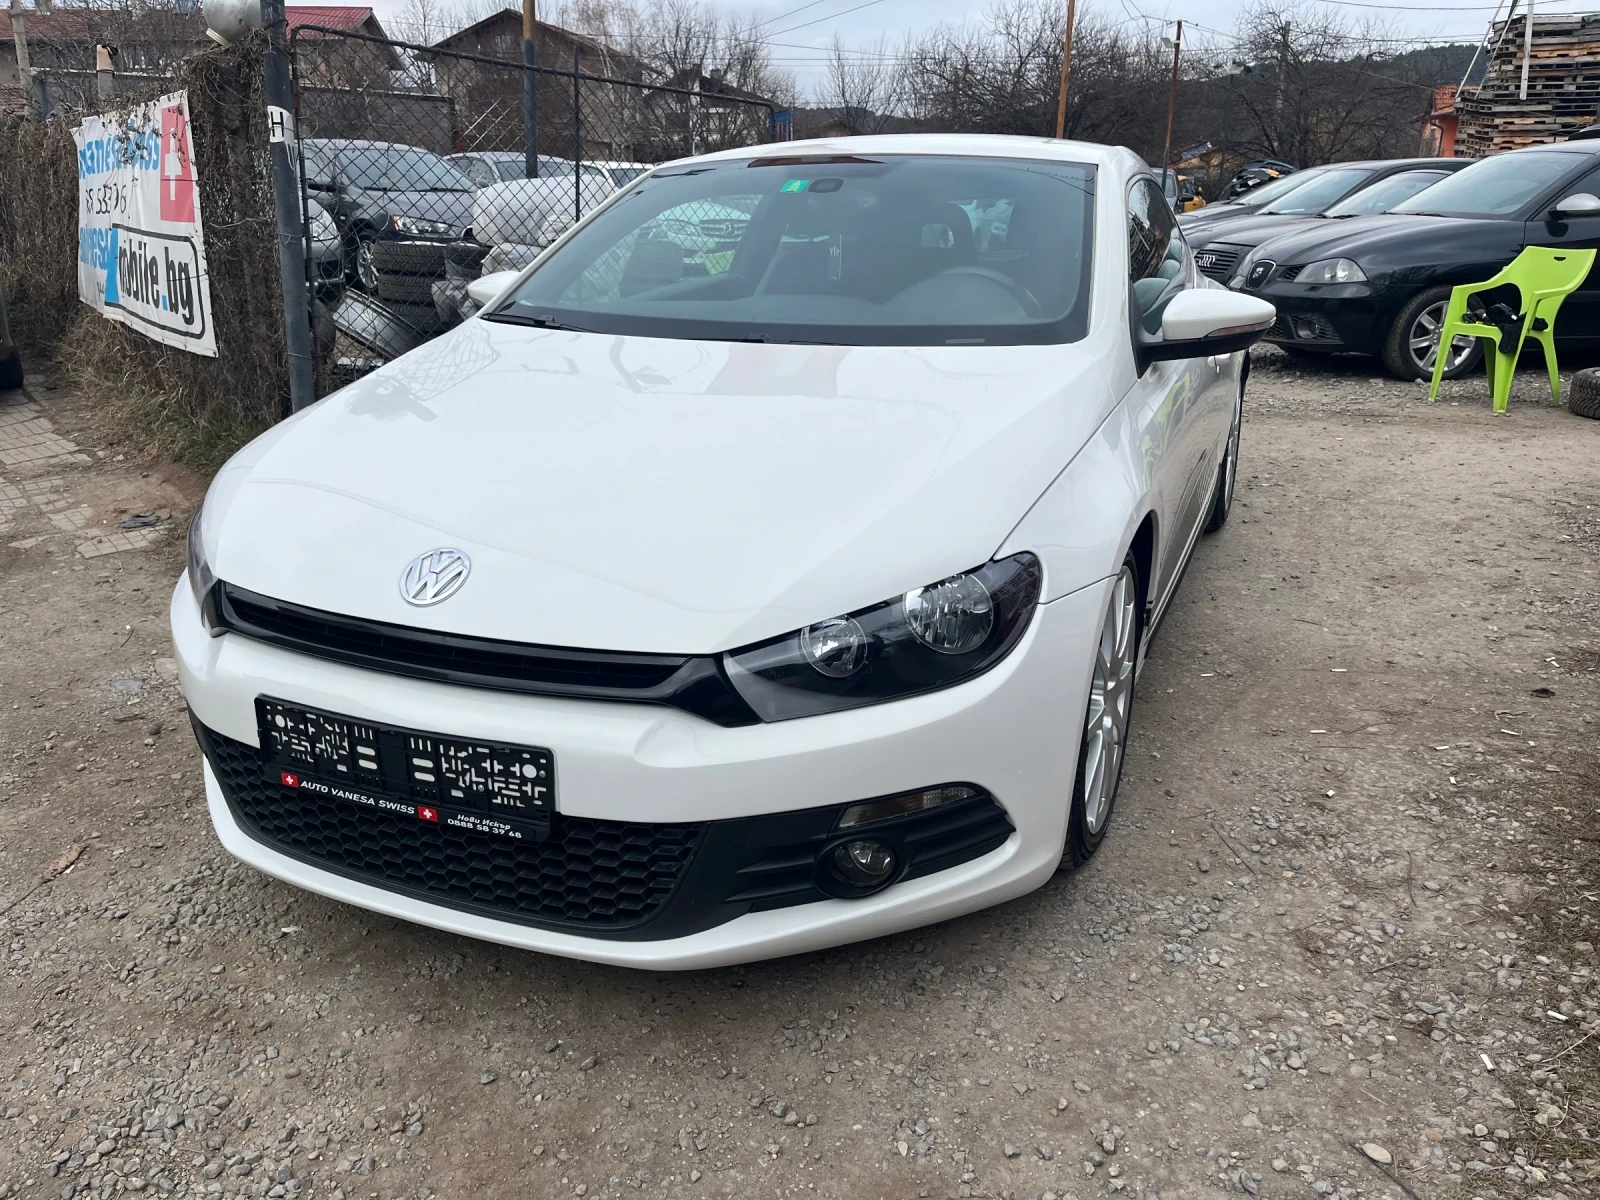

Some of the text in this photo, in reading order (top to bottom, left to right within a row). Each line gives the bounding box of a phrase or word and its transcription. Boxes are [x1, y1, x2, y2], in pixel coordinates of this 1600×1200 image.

[300, 780, 416, 815] AUTO VANESA SWISS
[447, 818, 523, 839] 0888 58 39 68
[457, 814, 480, 824] Нови
